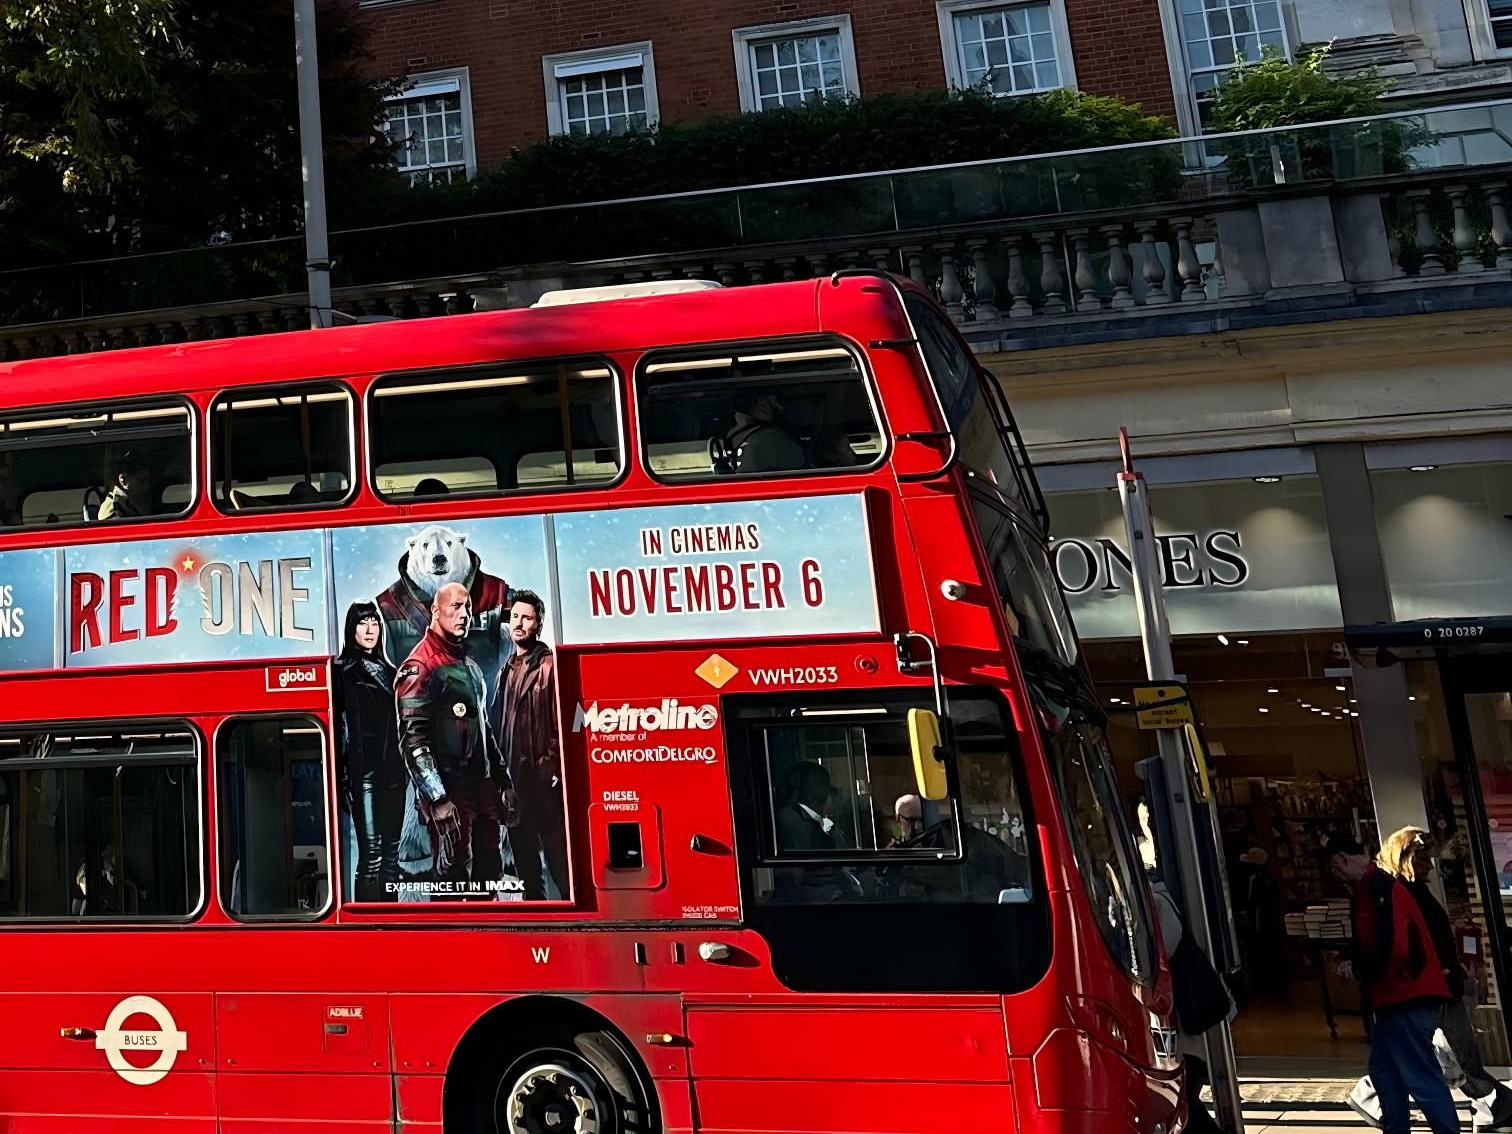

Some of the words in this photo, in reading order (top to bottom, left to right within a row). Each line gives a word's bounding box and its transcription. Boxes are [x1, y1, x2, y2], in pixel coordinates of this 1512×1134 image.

[641, 529, 662, 556] IN
[670, 524, 760, 554] CINEMAS
[589, 562, 785, 617] NOVEMBER
[801, 559, 824, 608] 6
[70, 566, 179, 656] RED
[199, 556, 315, 643] ONE
[278, 668, 317, 687] global
[747, 666, 839, 685] VWH2033
[572, 698, 718, 733] Metroline
[590, 733, 598, 743] A
[599, 732, 636, 742] member
[603, 791, 639, 802] DIESEL
[385, 881, 453, 892] EXPERIENCE
[456, 881, 466, 892] IT
[469, 881, 481, 892] IN
[485, 880, 525, 891] IMAX
[531, 947, 550, 964] W
[329, 1008, 363, 1018] ADBLUE
[124, 1034, 157, 1046] BUSES
